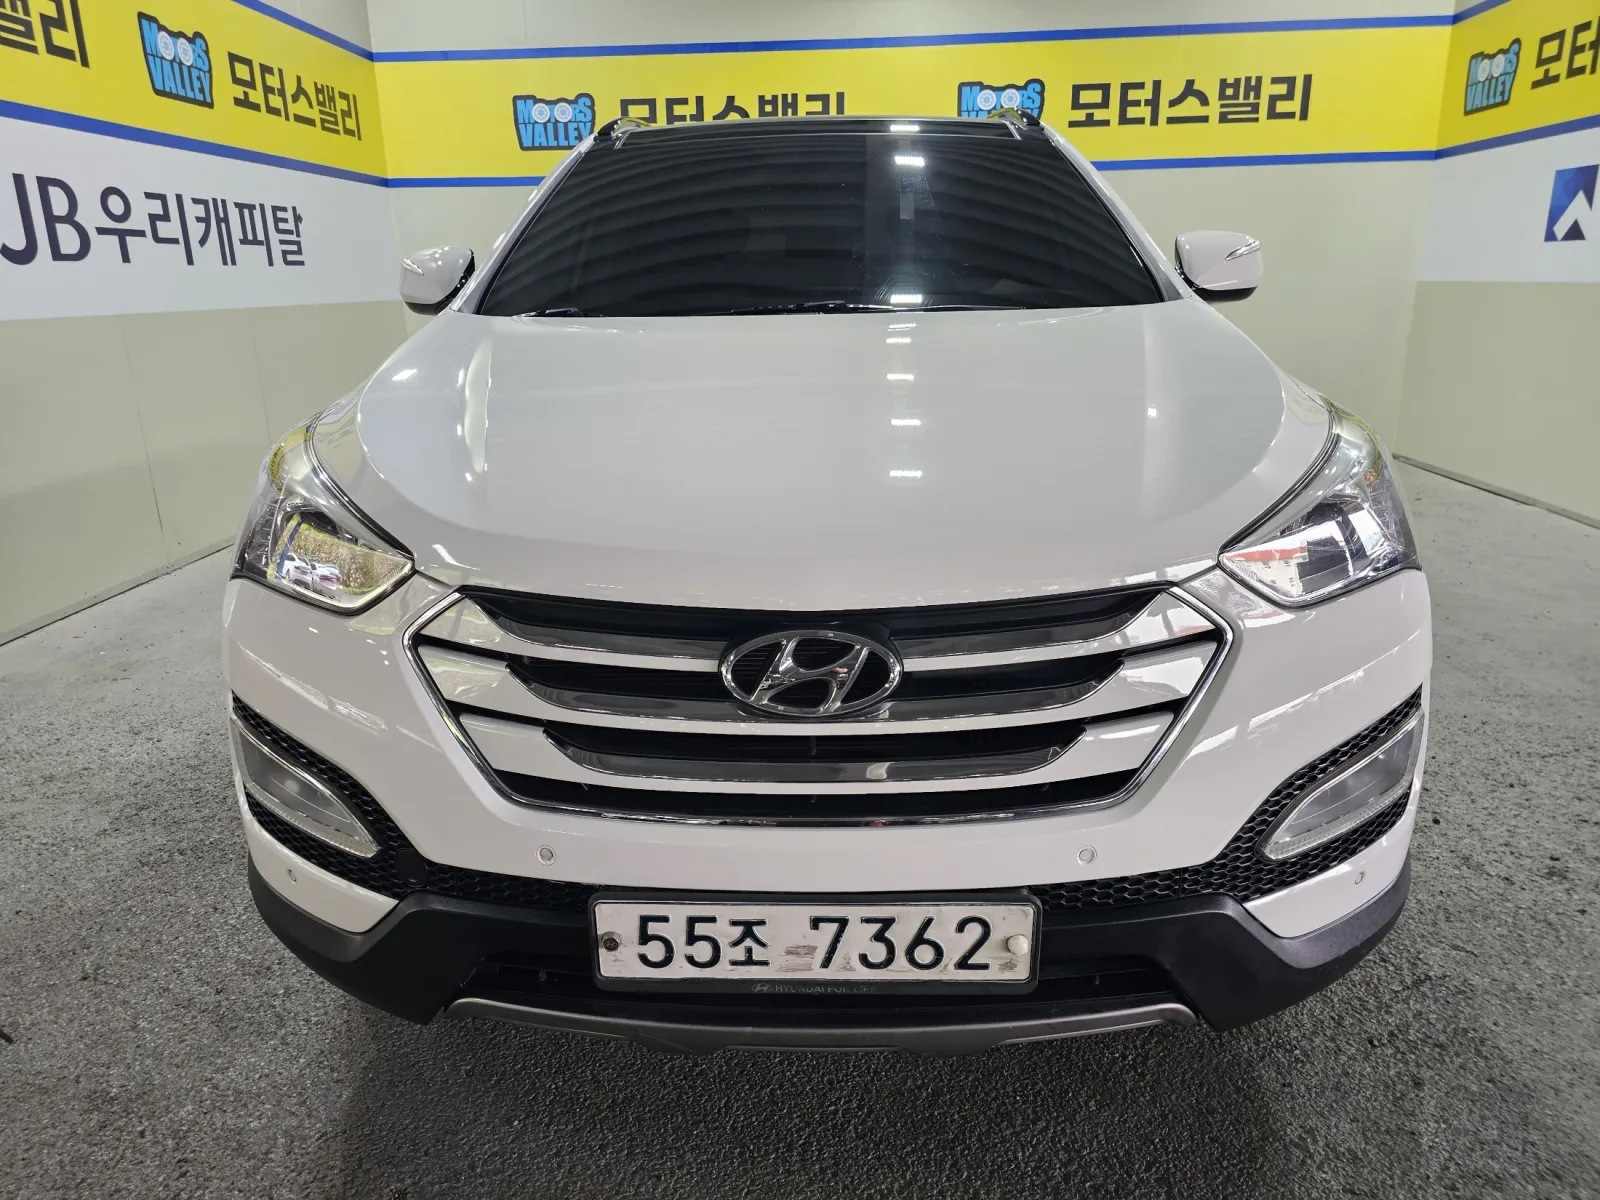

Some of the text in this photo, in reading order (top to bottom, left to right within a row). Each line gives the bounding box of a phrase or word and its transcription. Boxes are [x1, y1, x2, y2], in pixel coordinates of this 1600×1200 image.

[141, 19, 210, 72] MOTORS
[147, 55, 212, 103] VALLEY
[227, 51, 362, 141] 모터스밸리
[961, 82, 1041, 111] MOTORS
[1068, 74, 1312, 128] 모터스밸리
[1466, 72, 1514, 111] VALLEY
[516, 97, 592, 123] MOTORS
[518, 122, 592, 147] VALLEY
[637, 914, 993, 971] 55조 7362
